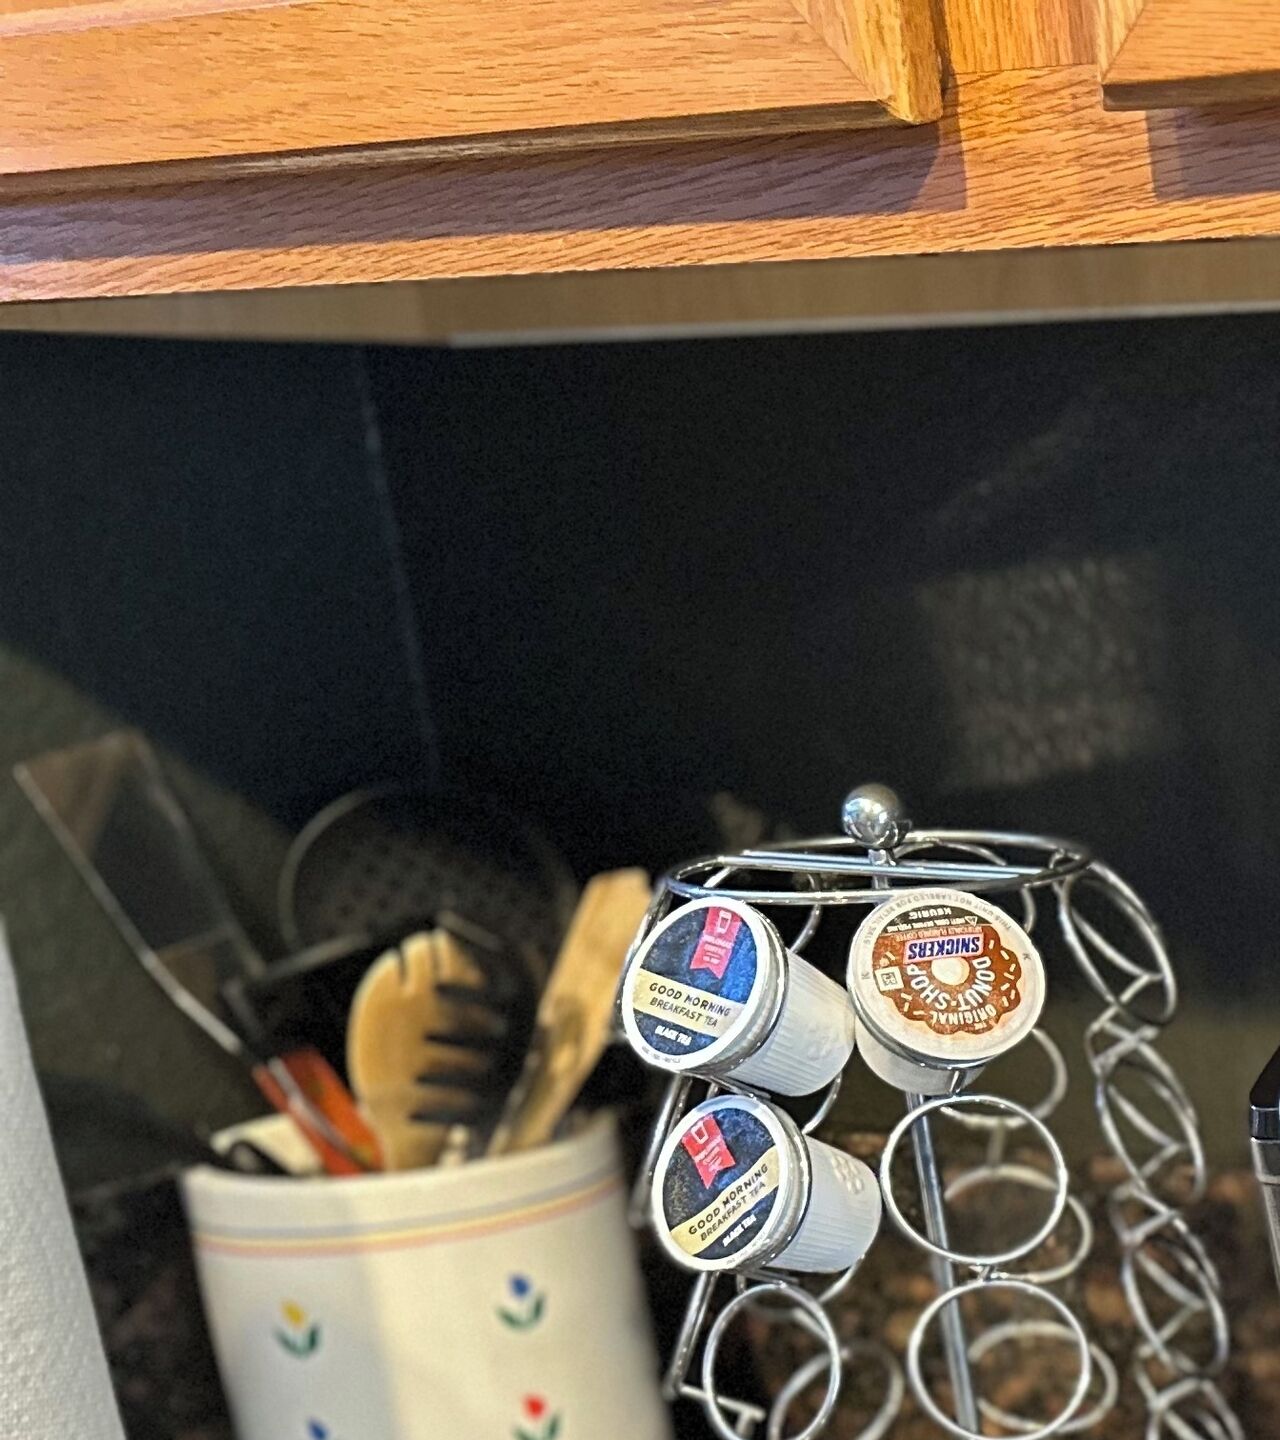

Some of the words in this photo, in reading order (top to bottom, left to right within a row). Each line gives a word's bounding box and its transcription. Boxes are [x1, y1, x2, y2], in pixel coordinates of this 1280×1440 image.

[908, 908, 952, 920] KEURIG
[908, 936, 980, 960] SNICKERS
[649, 982, 682, 1000] GOOD
[684, 994, 732, 1016] MORNING
[907, 964, 948, 1009] SHOP
[650, 997, 702, 1022] BREAKFAST
[705, 1015, 718, 1028] TEA
[929, 1003, 997, 1025] ORIGINAL
[688, 1207, 721, 1236] GOOD
[722, 1163, 768, 1208] MORNING
[700, 1195, 747, 1241] BREAKFAST
[749, 1181, 766, 1198] TEA
